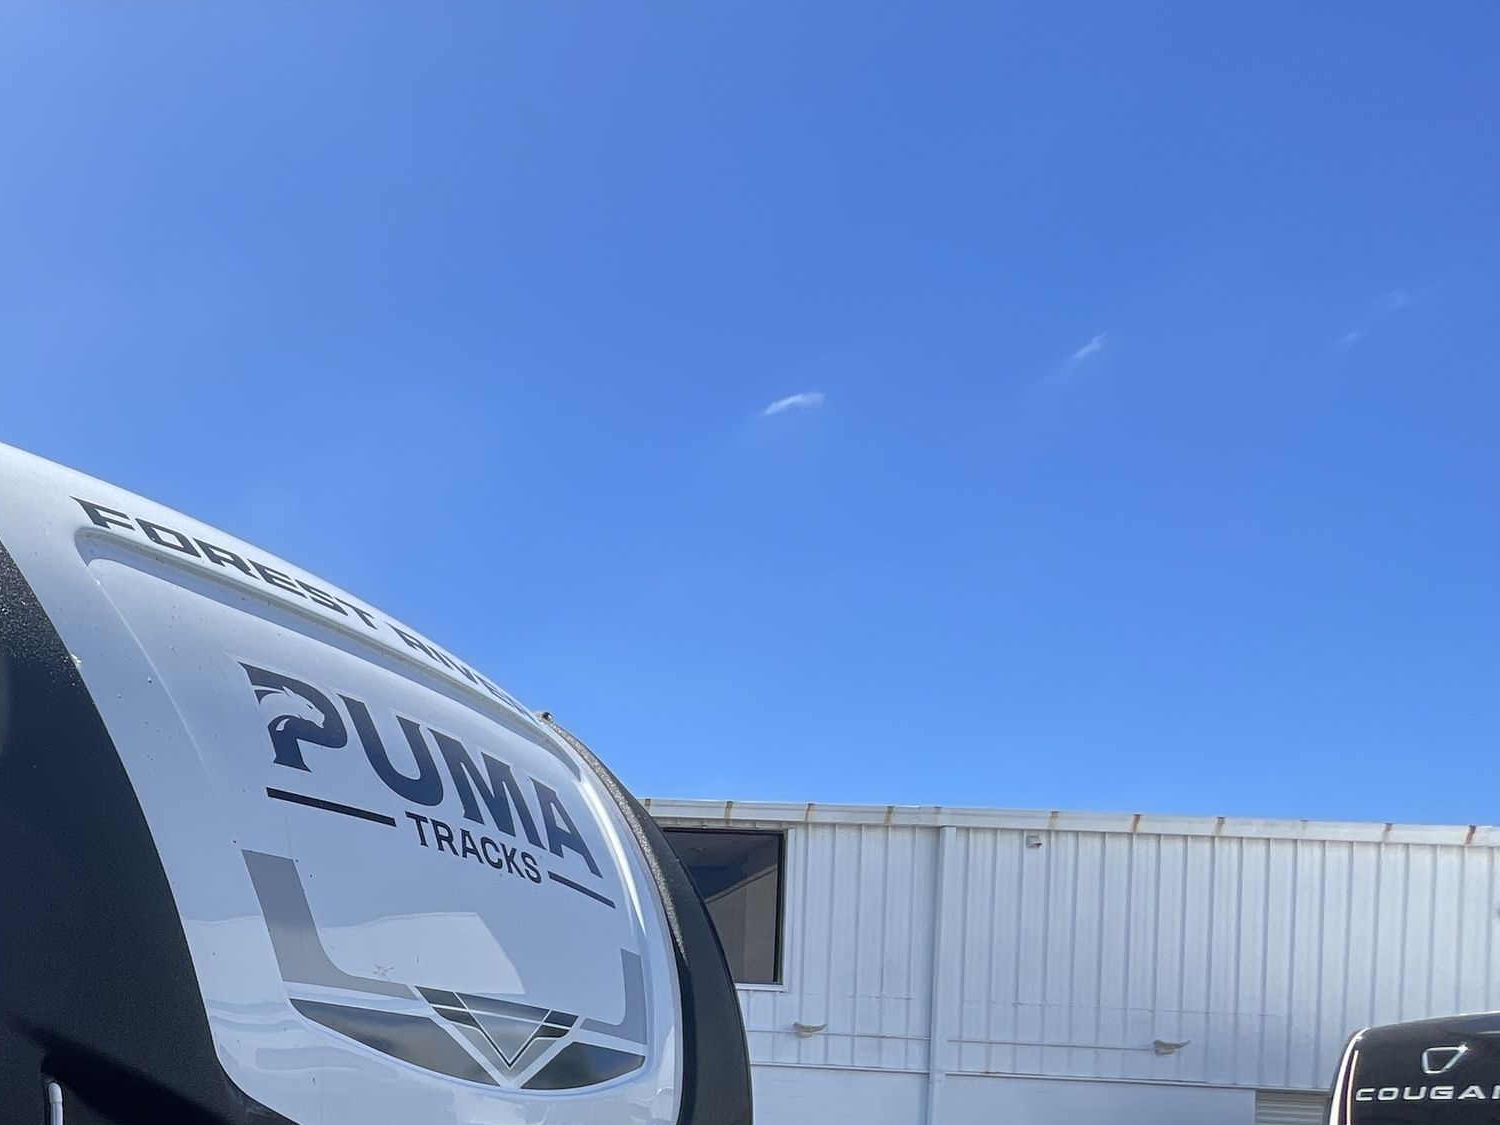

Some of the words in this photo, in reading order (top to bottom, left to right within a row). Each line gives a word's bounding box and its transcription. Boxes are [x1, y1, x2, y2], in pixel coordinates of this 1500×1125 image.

[70, 496, 377, 630] FOREST
[384, 622, 539, 726] RIVER
[239, 662, 603, 878] PUMA
[405, 811, 542, 884] TRACKS
